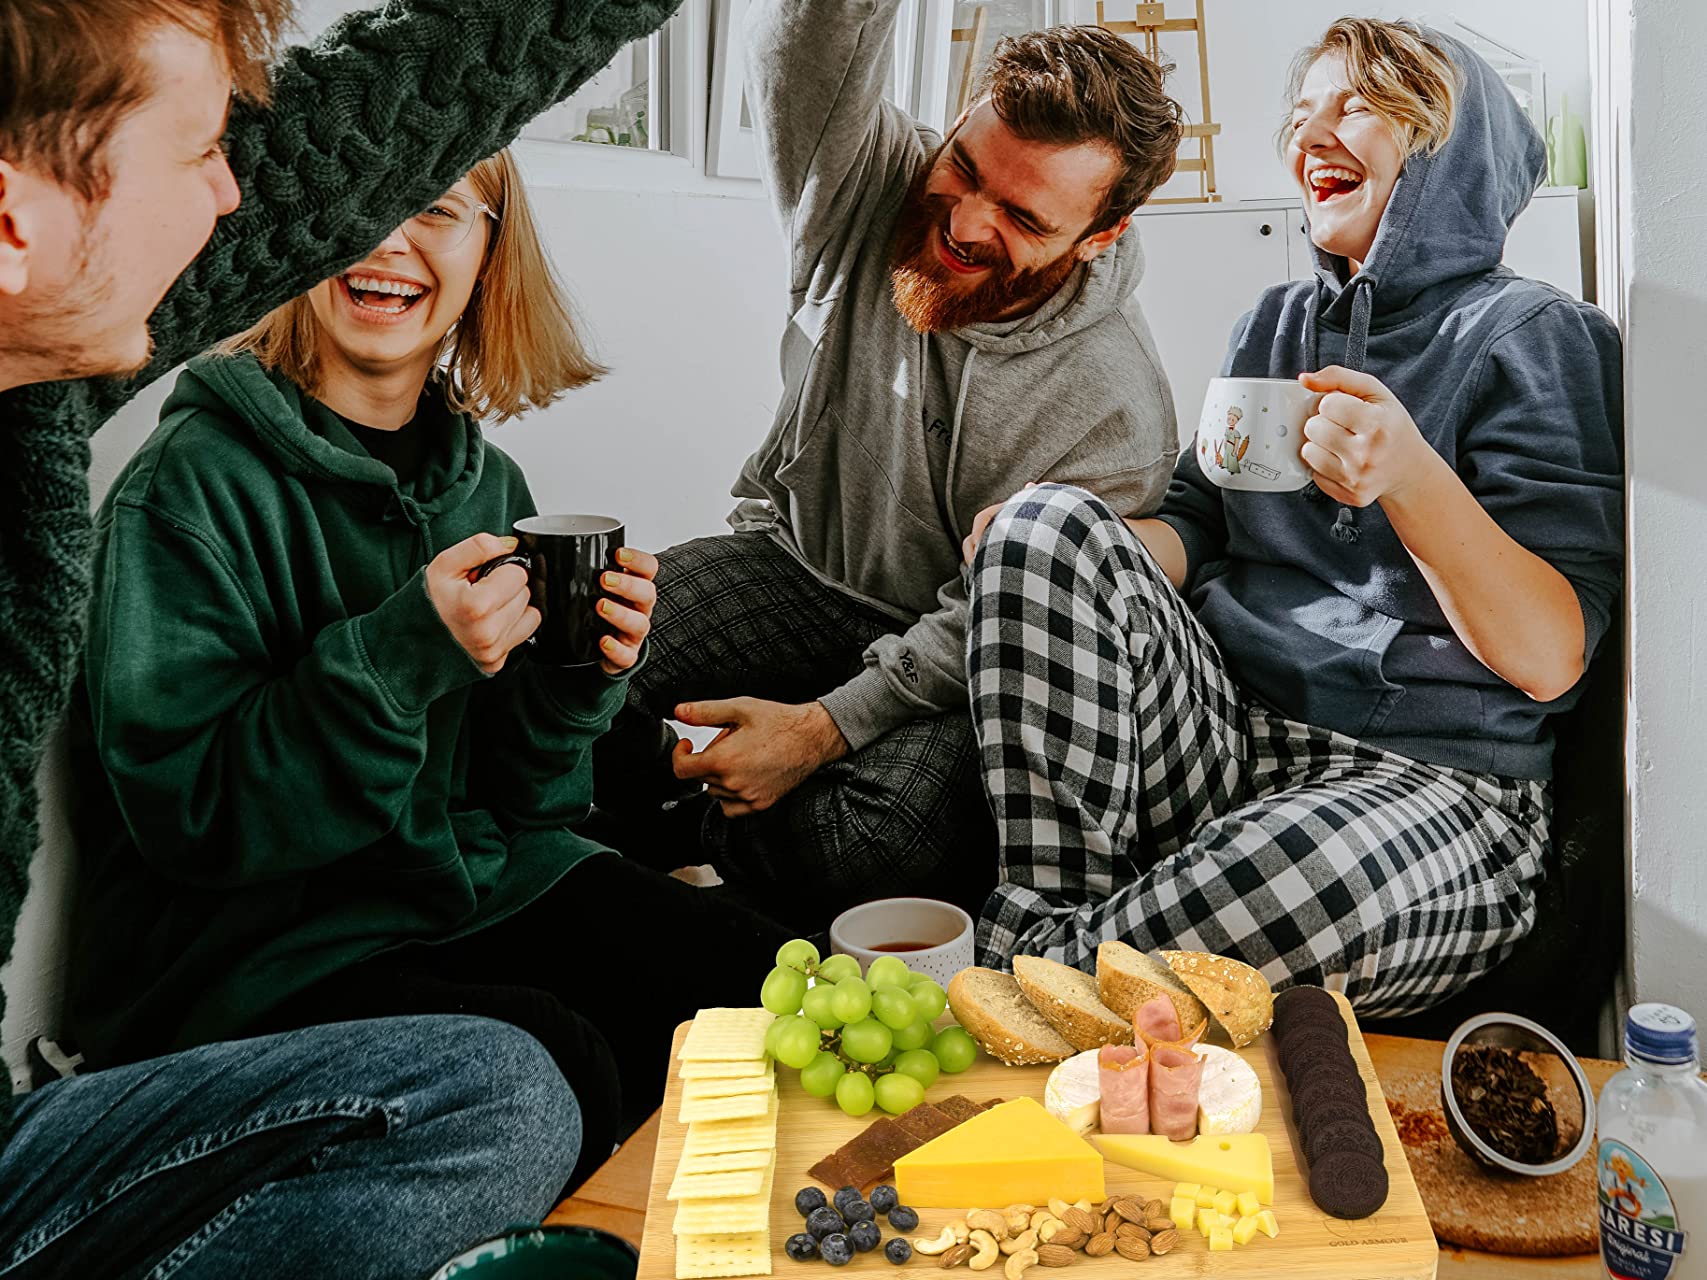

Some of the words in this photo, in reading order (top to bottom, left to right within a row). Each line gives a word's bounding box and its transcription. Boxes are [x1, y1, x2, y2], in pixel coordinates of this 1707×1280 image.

[928, 418, 959, 452] Fre
[899, 648, 918, 683] Y&F
[1329, 1239, 1359, 1247] GOLD
[1361, 1237, 1409, 1246] ARMOUR
